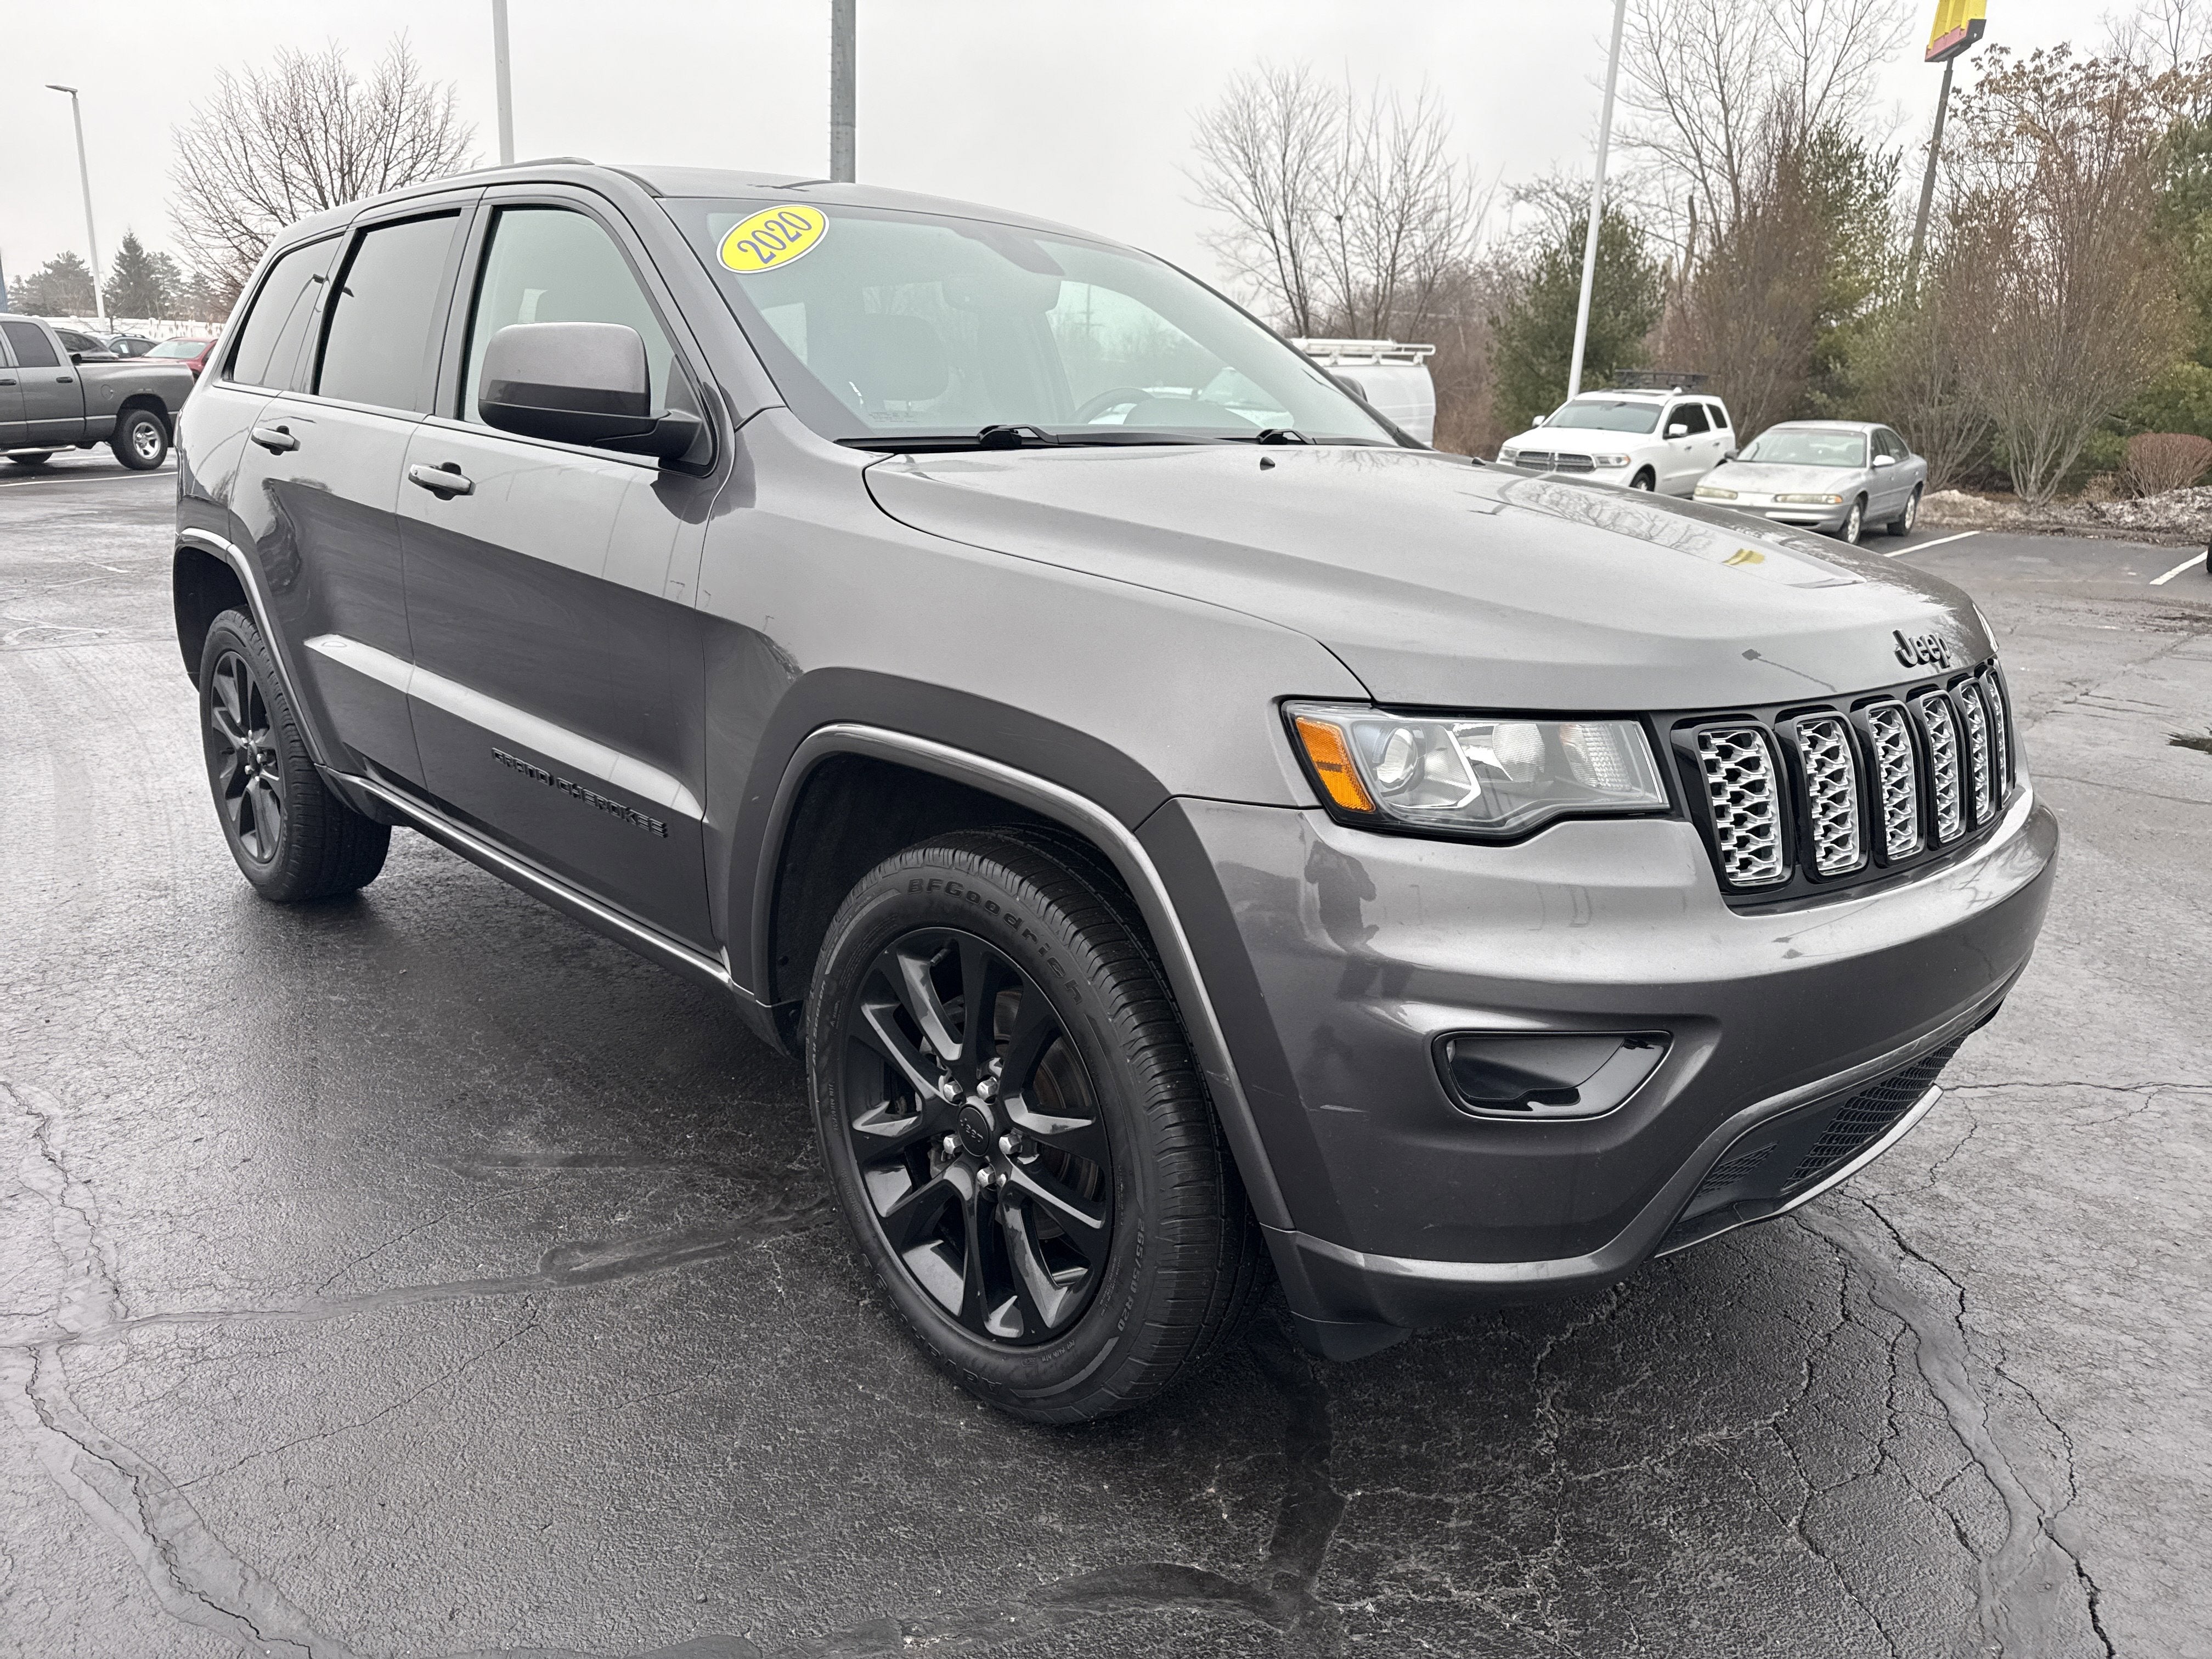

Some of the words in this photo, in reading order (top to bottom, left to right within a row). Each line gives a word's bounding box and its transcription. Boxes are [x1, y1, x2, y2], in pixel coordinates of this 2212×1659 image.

[737, 211, 812, 264] 2020
[1893, 629, 1951, 669] Jeep
[492, 747, 554, 786] GRAND
[557, 777, 668, 838] CHEROKEE
[908, 878, 1083, 1005] BFGoodrich
[1131, 1217, 1145, 1293] 265/50
[1118, 1295, 1134, 1331] R20
